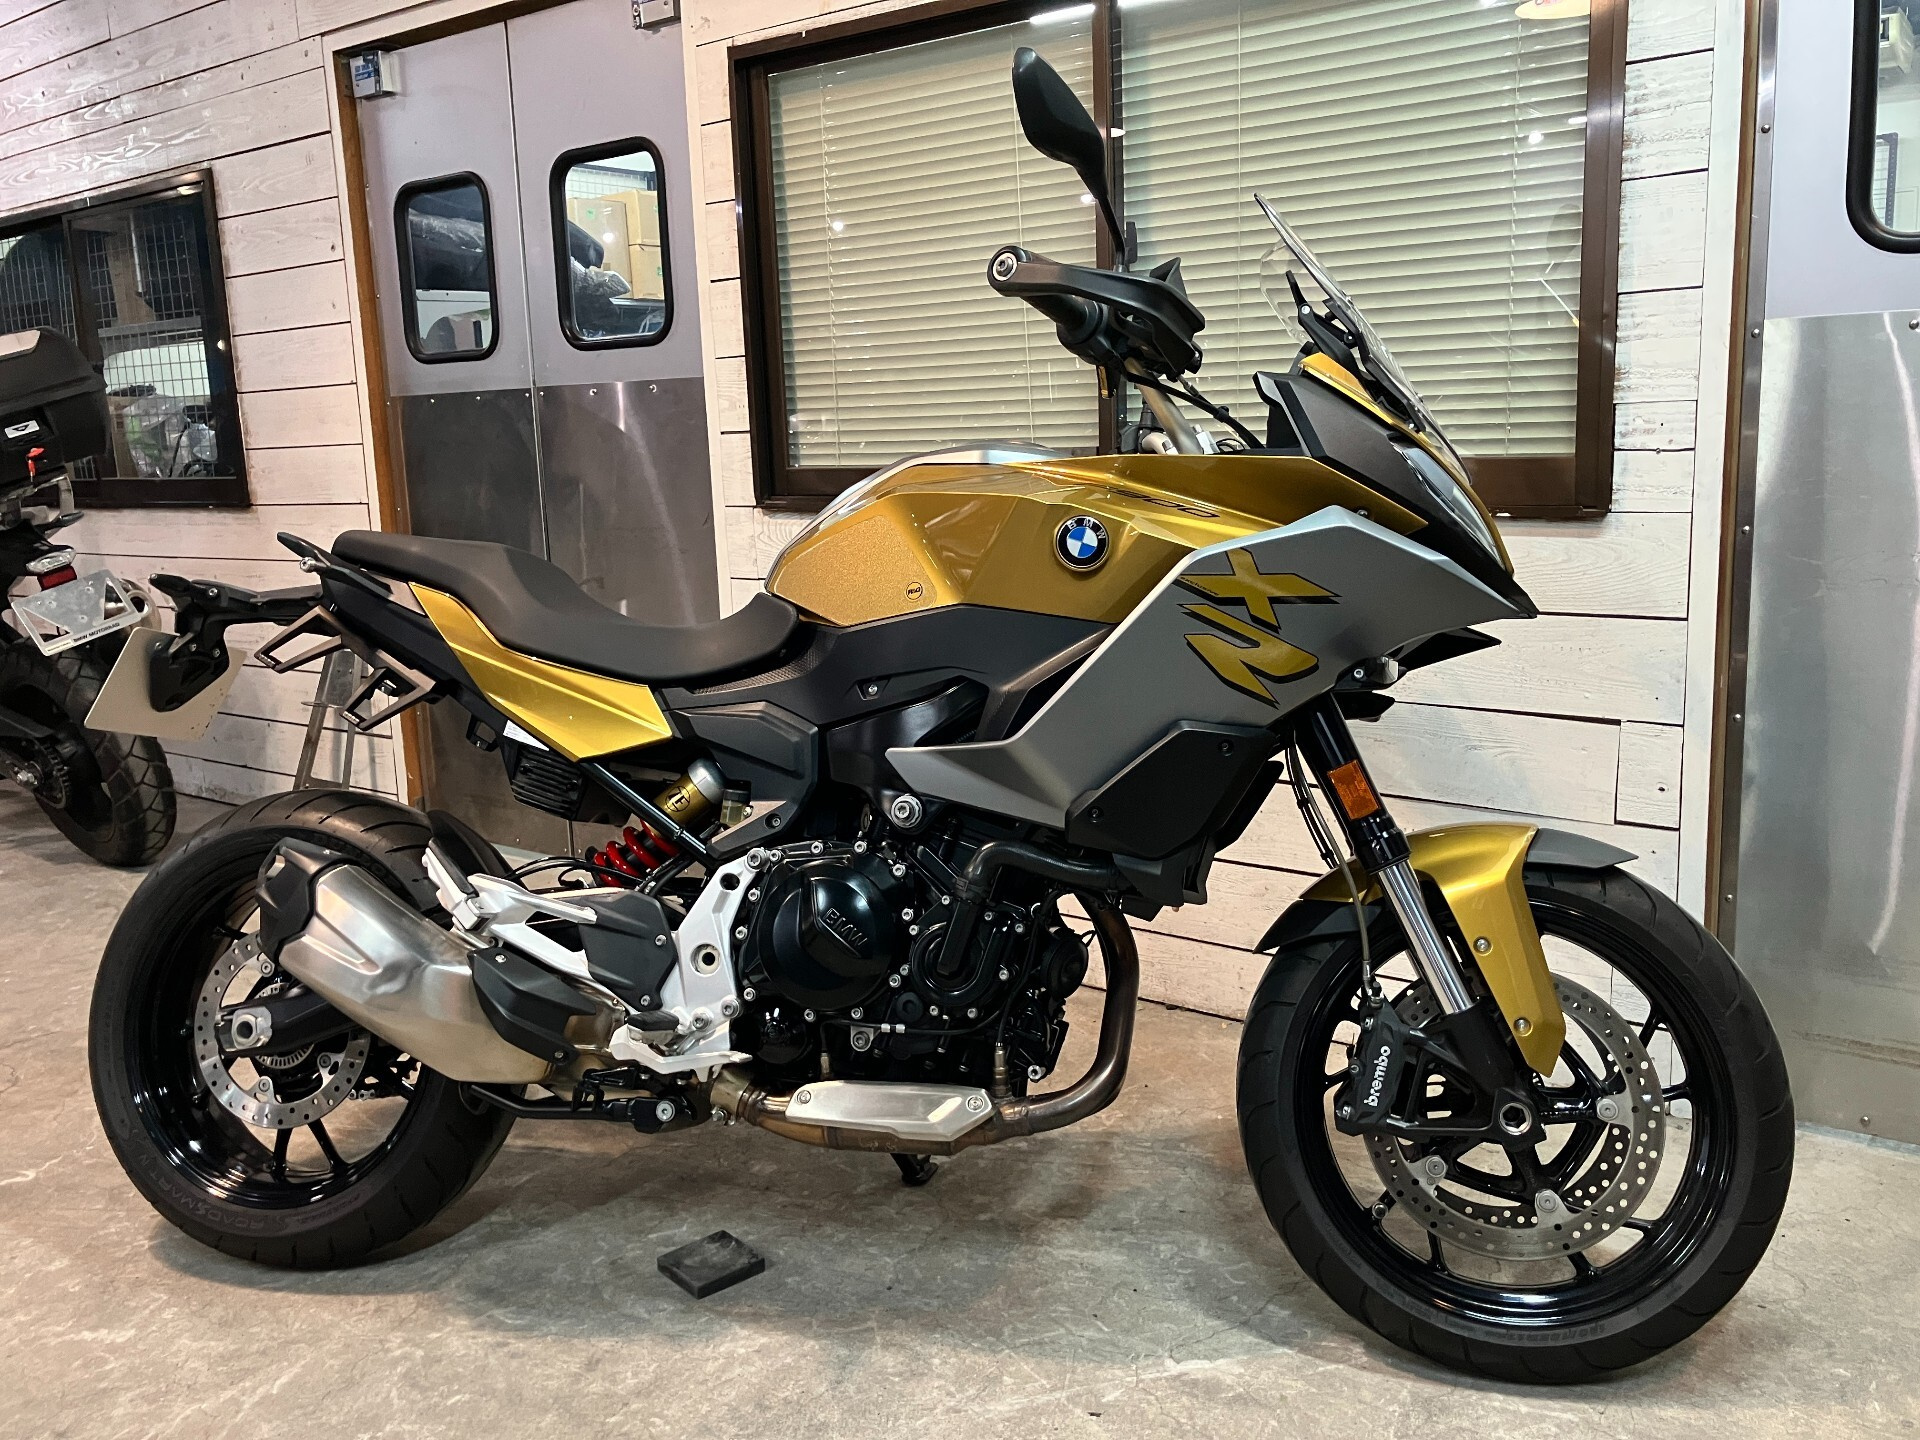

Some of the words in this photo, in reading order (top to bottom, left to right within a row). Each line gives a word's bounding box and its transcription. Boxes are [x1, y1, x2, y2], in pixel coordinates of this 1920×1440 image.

[1067, 518, 1106, 539] BMW
[822, 907, 868, 946] BMW
[1363, 1045, 1391, 1107] brembo
